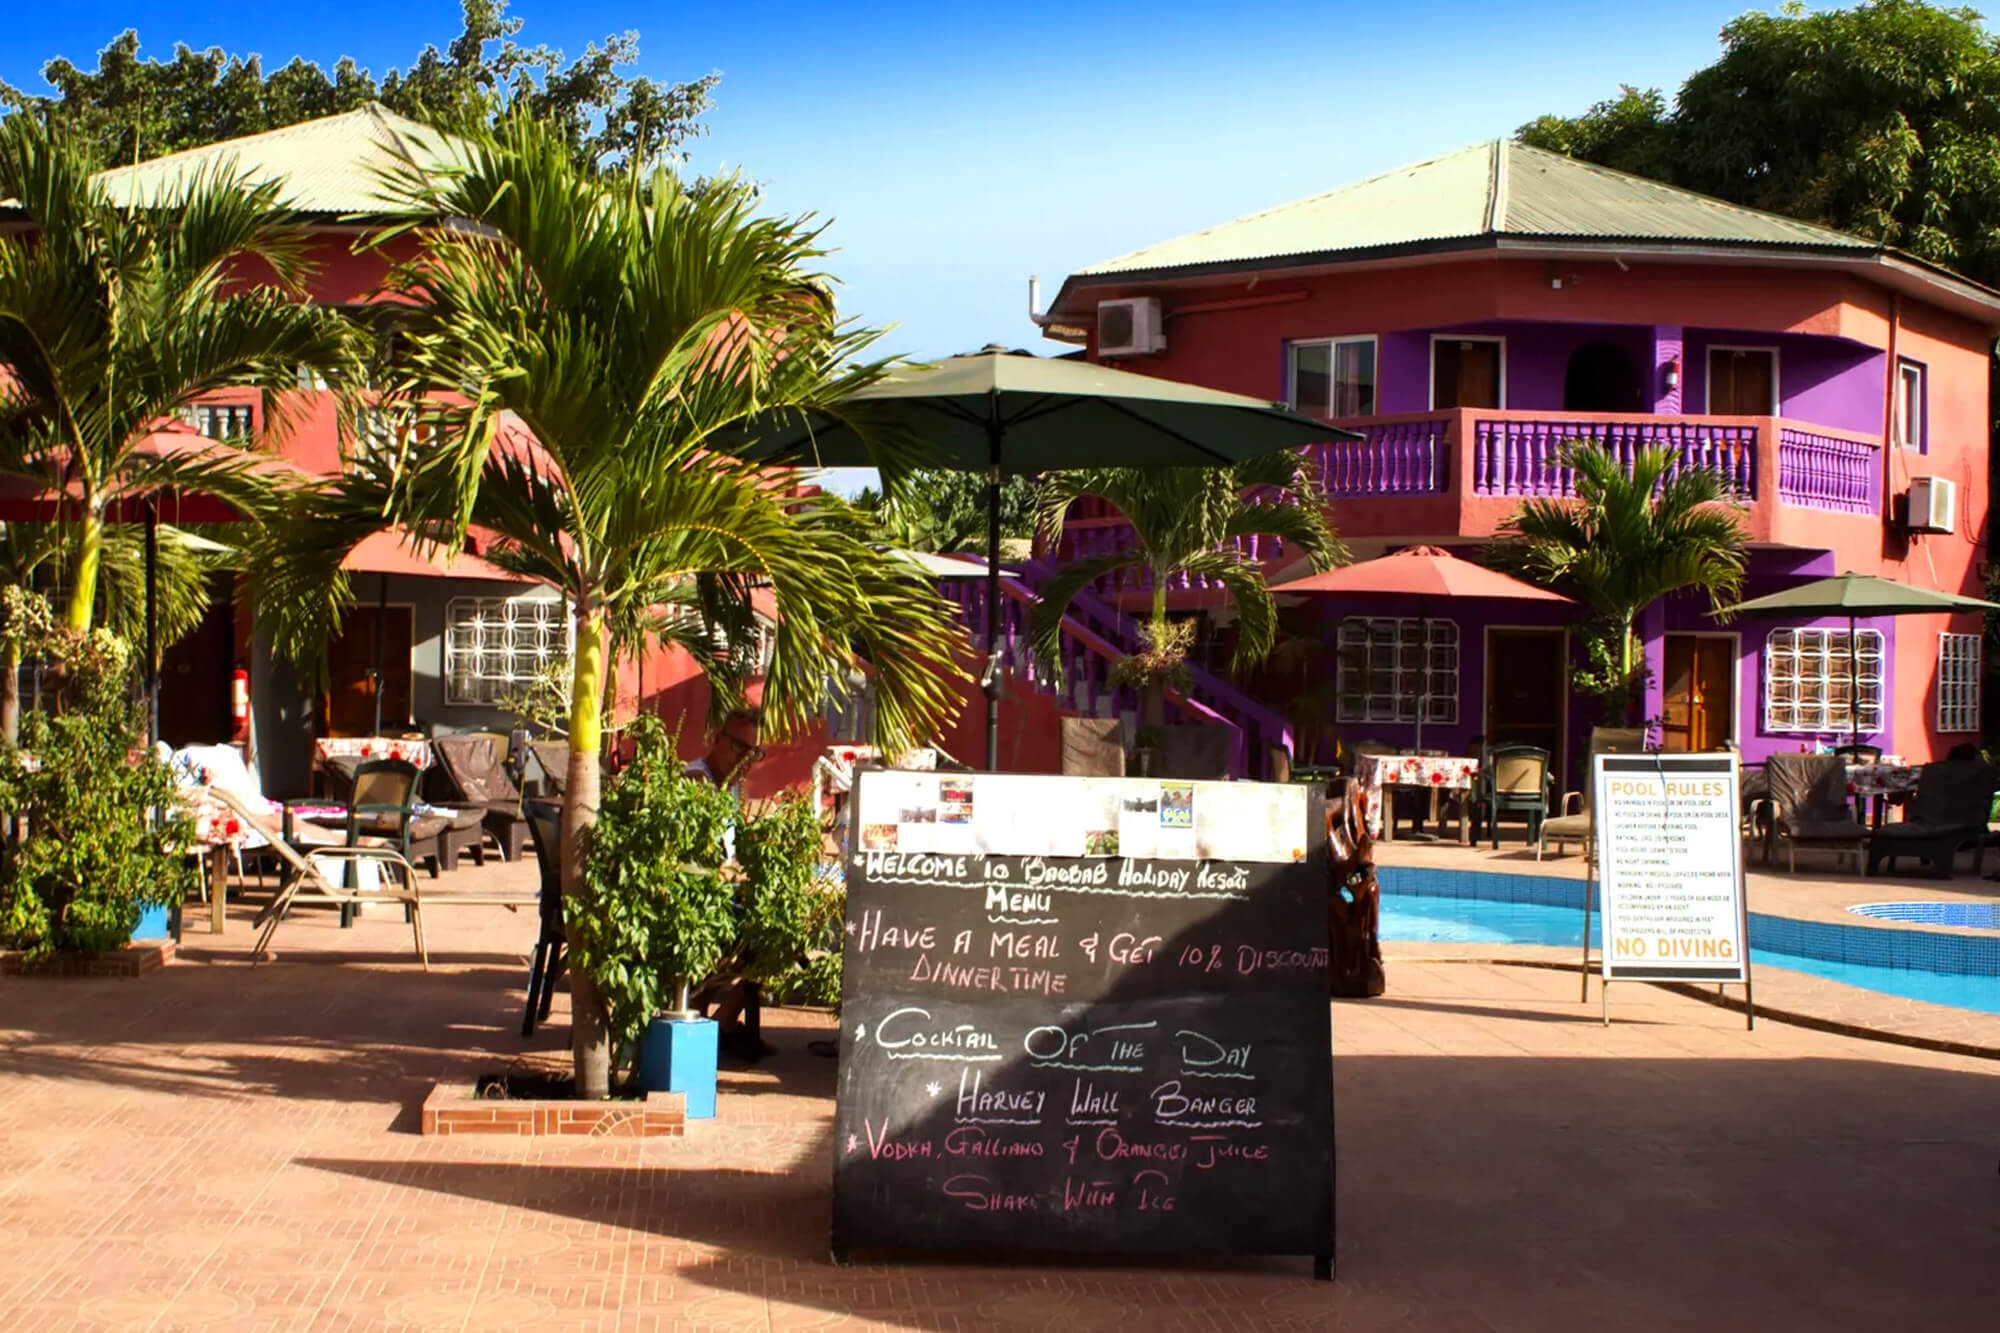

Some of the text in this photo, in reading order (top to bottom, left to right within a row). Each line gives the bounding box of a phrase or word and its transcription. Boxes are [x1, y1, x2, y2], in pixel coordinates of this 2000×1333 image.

[1611, 782, 1723, 797] POOL RULES
[866, 852, 967, 878] WELCOME
[985, 886, 1051, 912] MENU
[859, 909, 936, 952] HAVE
[953, 930, 972, 954] A
[990, 932, 1060, 958] MEAL
[1109, 933, 1162, 964] GET
[1179, 944, 1222, 972] 10%
[1237, 945, 1328, 975] DISCOUNT
[1616, 938, 1733, 958] NO DIVING
[910, 953, 1068, 995] DINNER TIME
[876, 1007, 1252, 1068] COCKTAIL OF THE DAY
[956, 1066, 1256, 1117] HARVEY WALL BANGER
[945, 1126, 1044, 1157] GALLIANO
[1064, 1177, 1117, 1210] WITH
